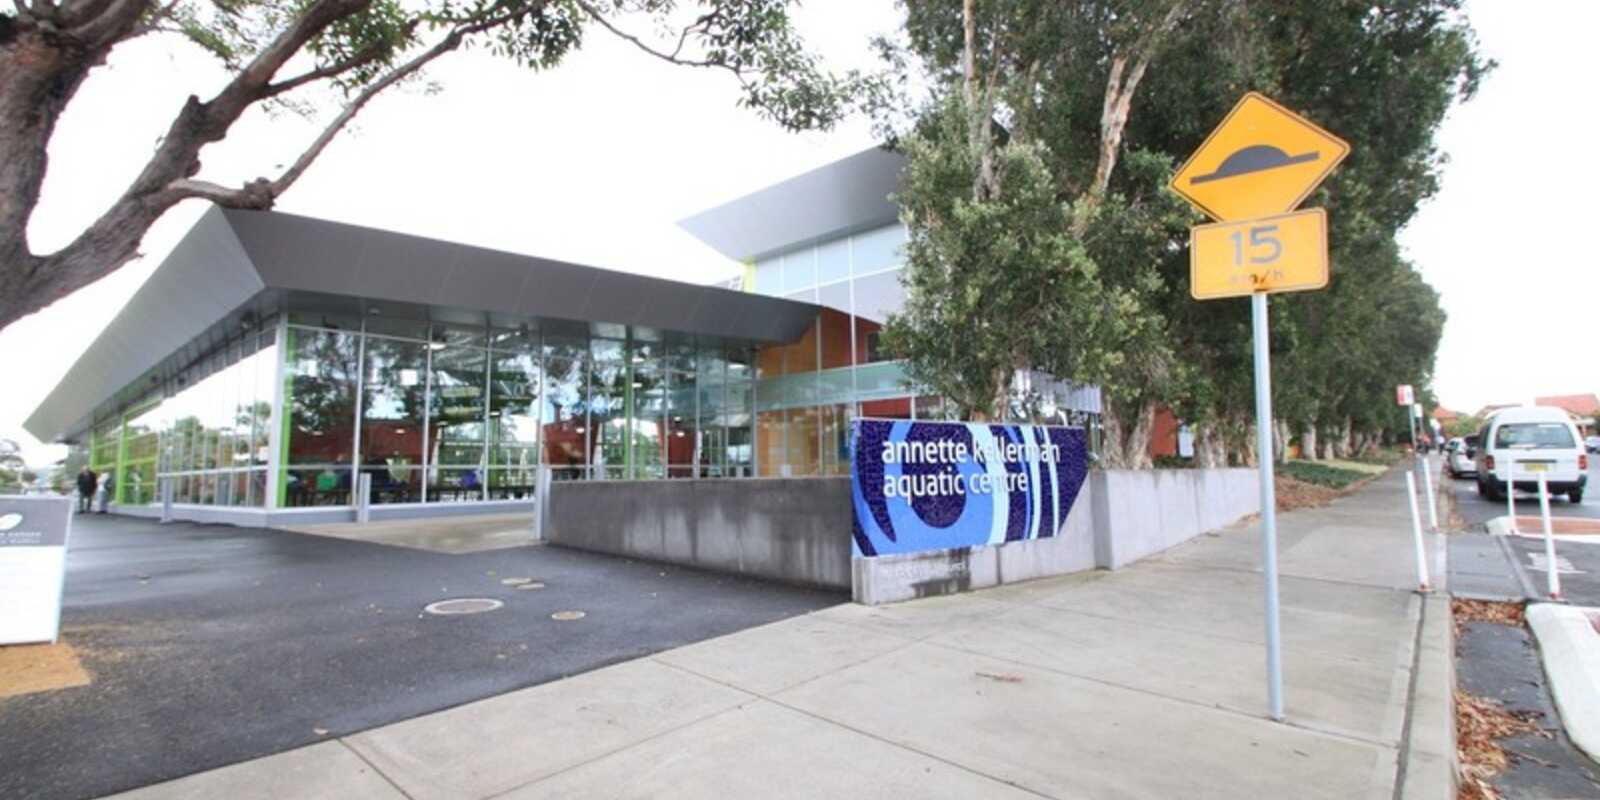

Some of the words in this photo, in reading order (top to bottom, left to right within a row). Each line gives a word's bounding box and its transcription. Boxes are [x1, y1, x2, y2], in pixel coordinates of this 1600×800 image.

[1227, 225, 1282, 267] 15
[881, 438, 967, 464] annette
[972, 436, 1061, 464] kellerman
[883, 467, 966, 506] aquatic
[969, 471, 1029, 494] centre
